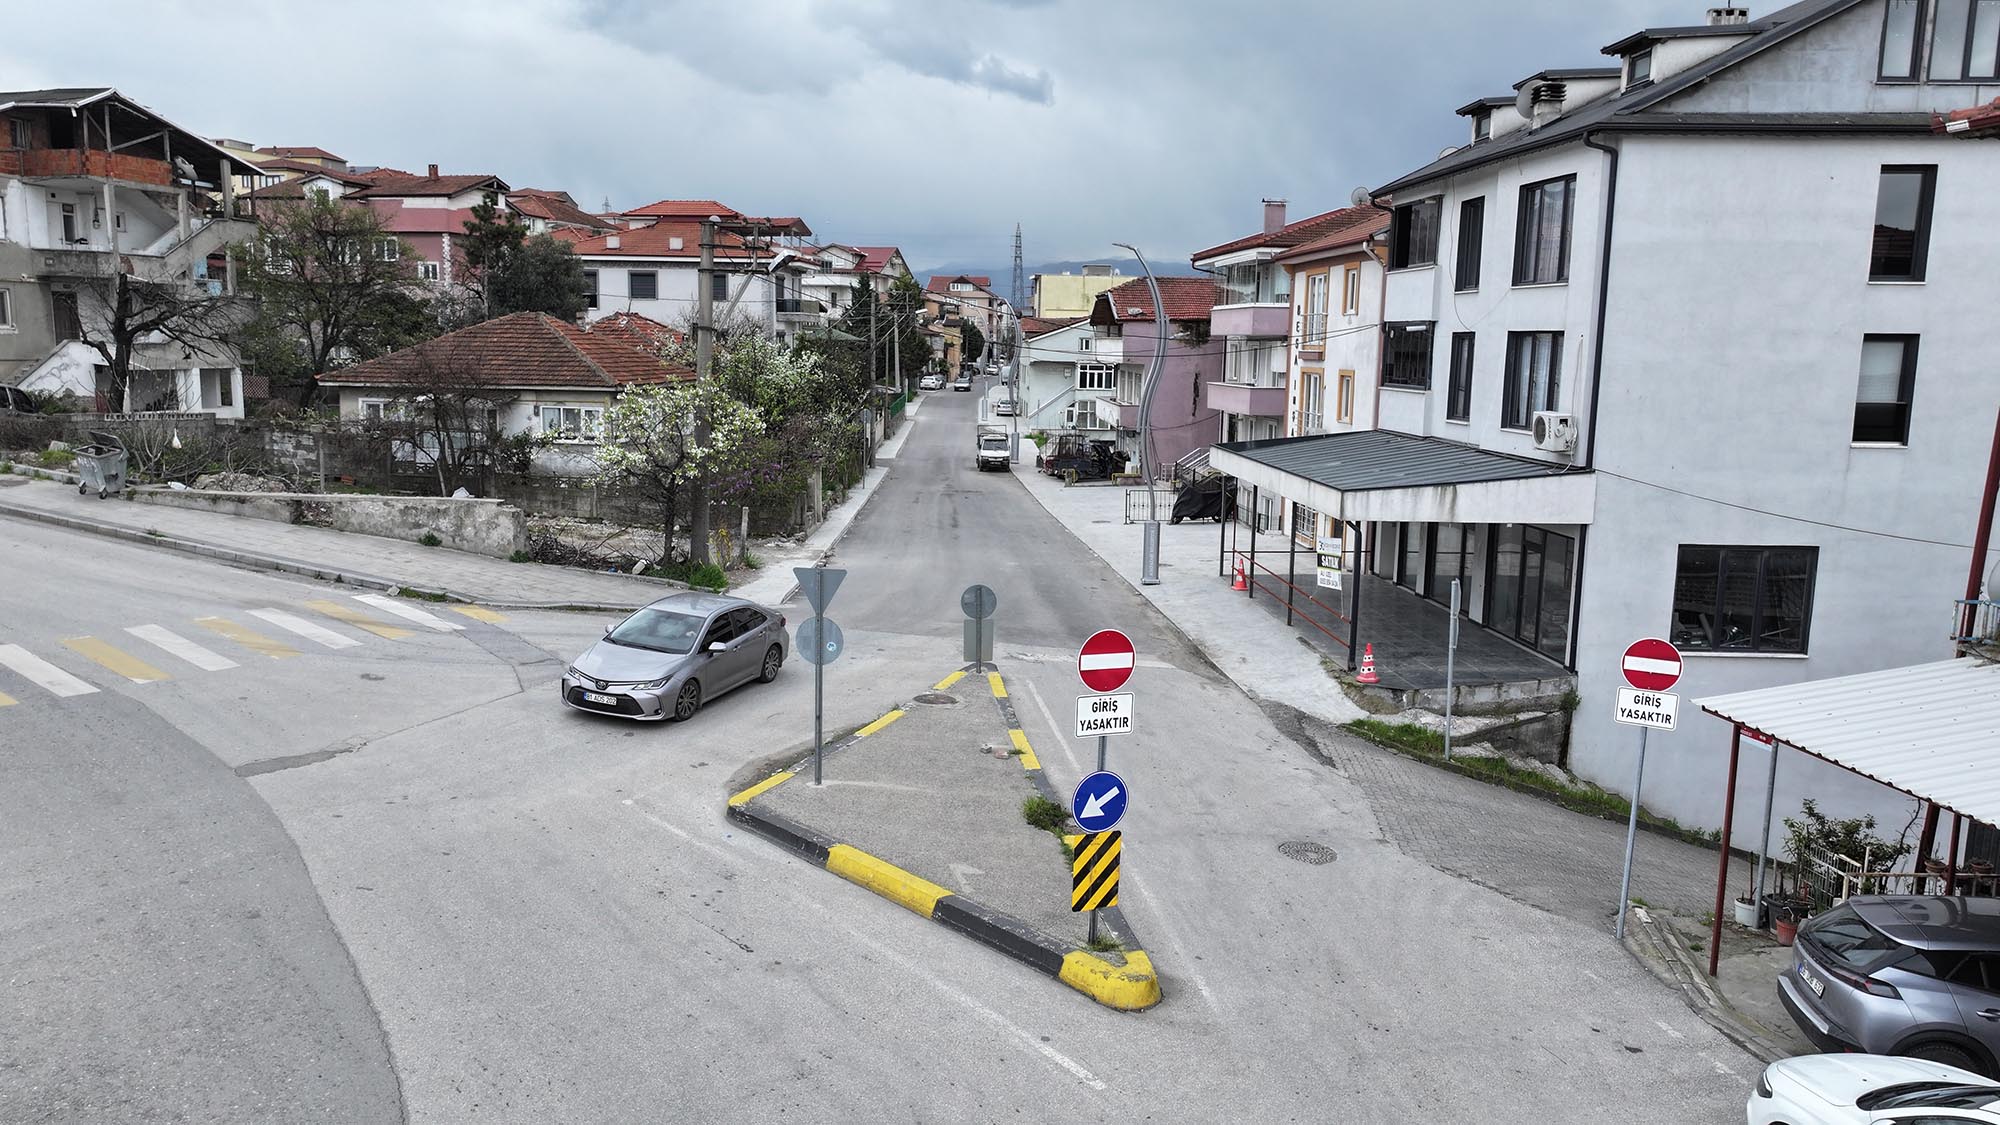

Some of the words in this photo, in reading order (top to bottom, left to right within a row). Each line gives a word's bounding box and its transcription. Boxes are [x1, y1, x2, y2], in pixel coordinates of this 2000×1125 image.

[1091, 697, 1118, 713] GİRİŞ
[1633, 692, 1662, 709] GİRİŞ
[1080, 716, 1129, 731] YASAKTIR
[1620, 707, 1672, 725] YASAKTIR
